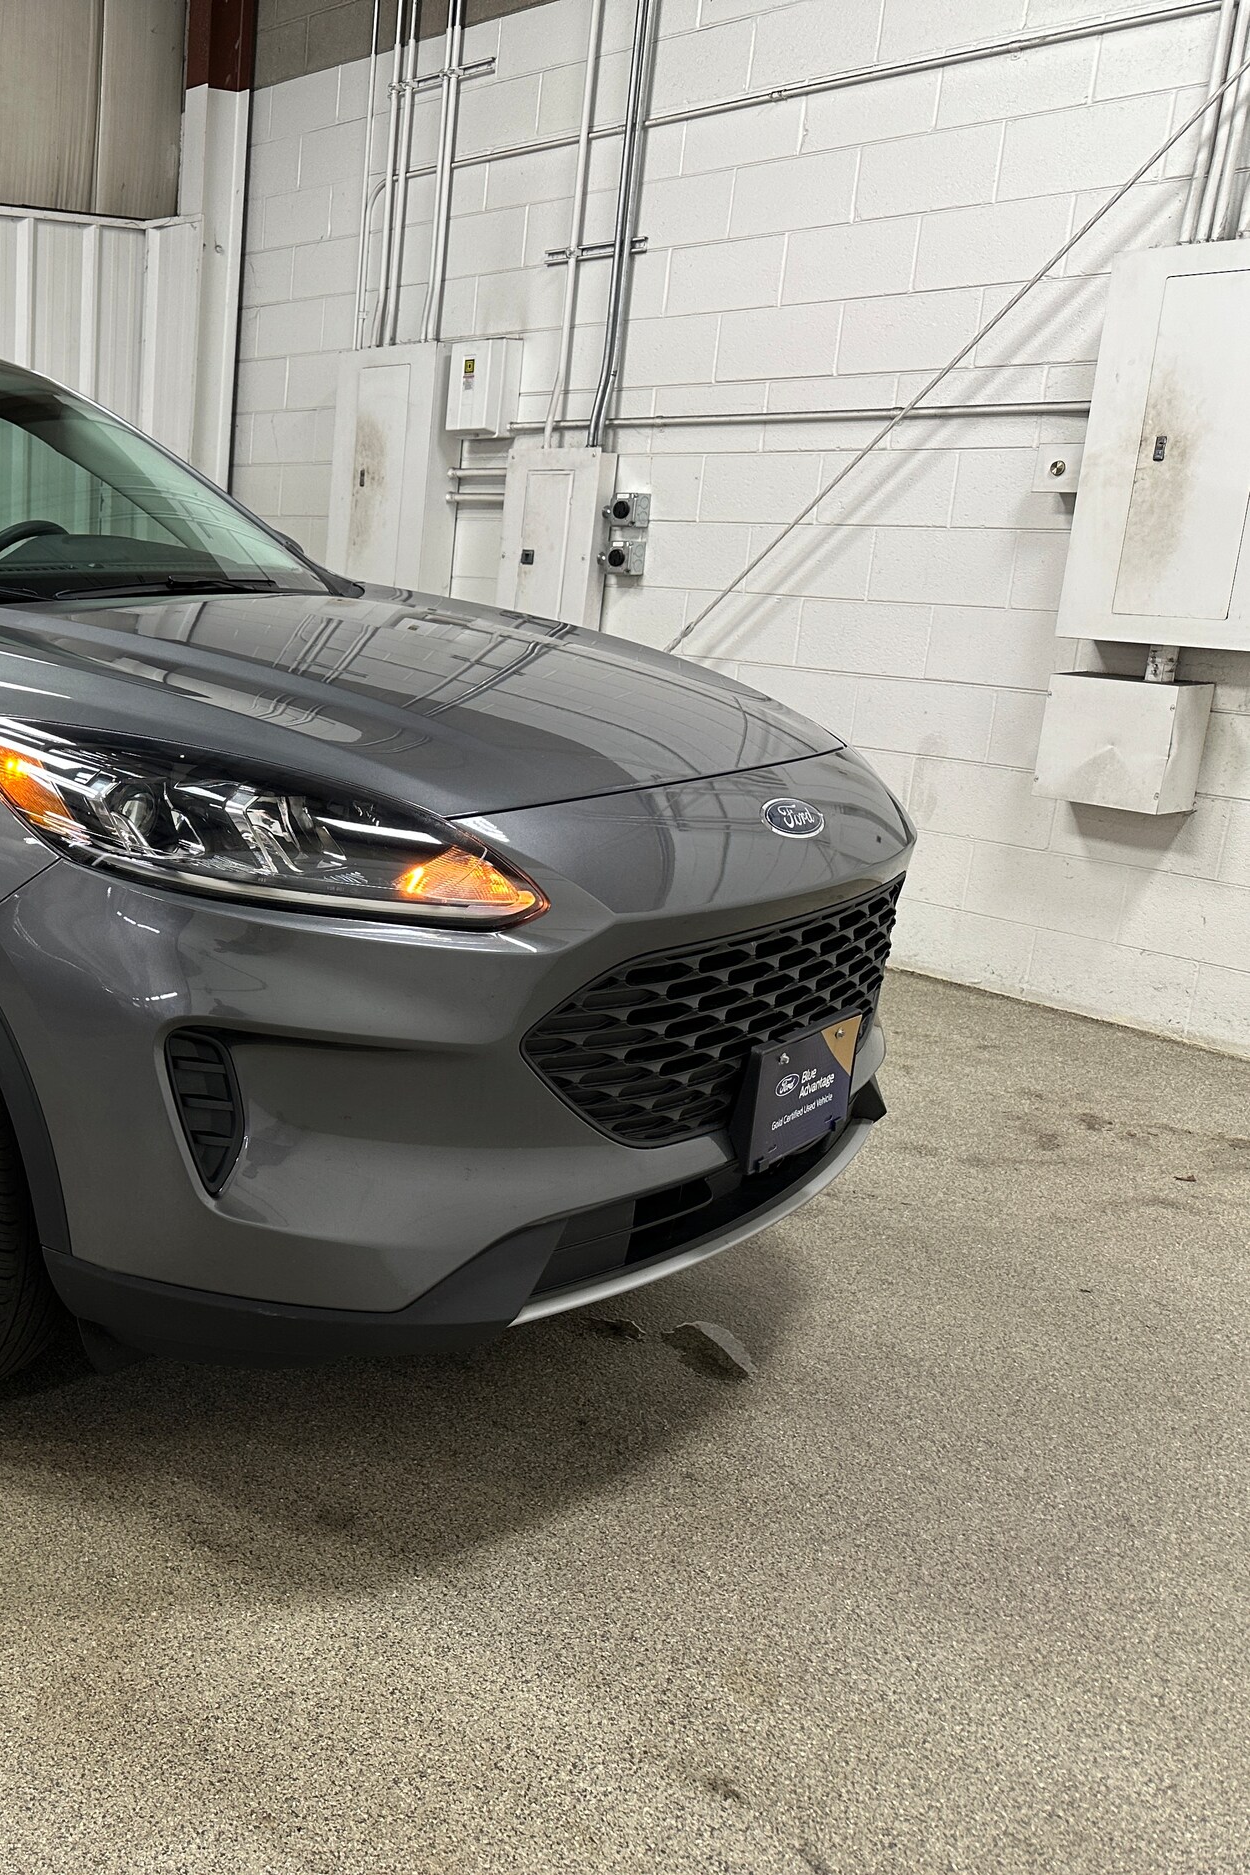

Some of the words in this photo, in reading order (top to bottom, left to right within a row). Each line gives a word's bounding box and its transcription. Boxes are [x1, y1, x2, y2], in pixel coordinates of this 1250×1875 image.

[777, 804, 815, 829] Ford
[798, 1073, 835, 1099] Advantage
[801, 1068, 817, 1084] Blue
[803, 1101, 816, 1114] Used
[816, 1092, 833, 1107] Vehicle
